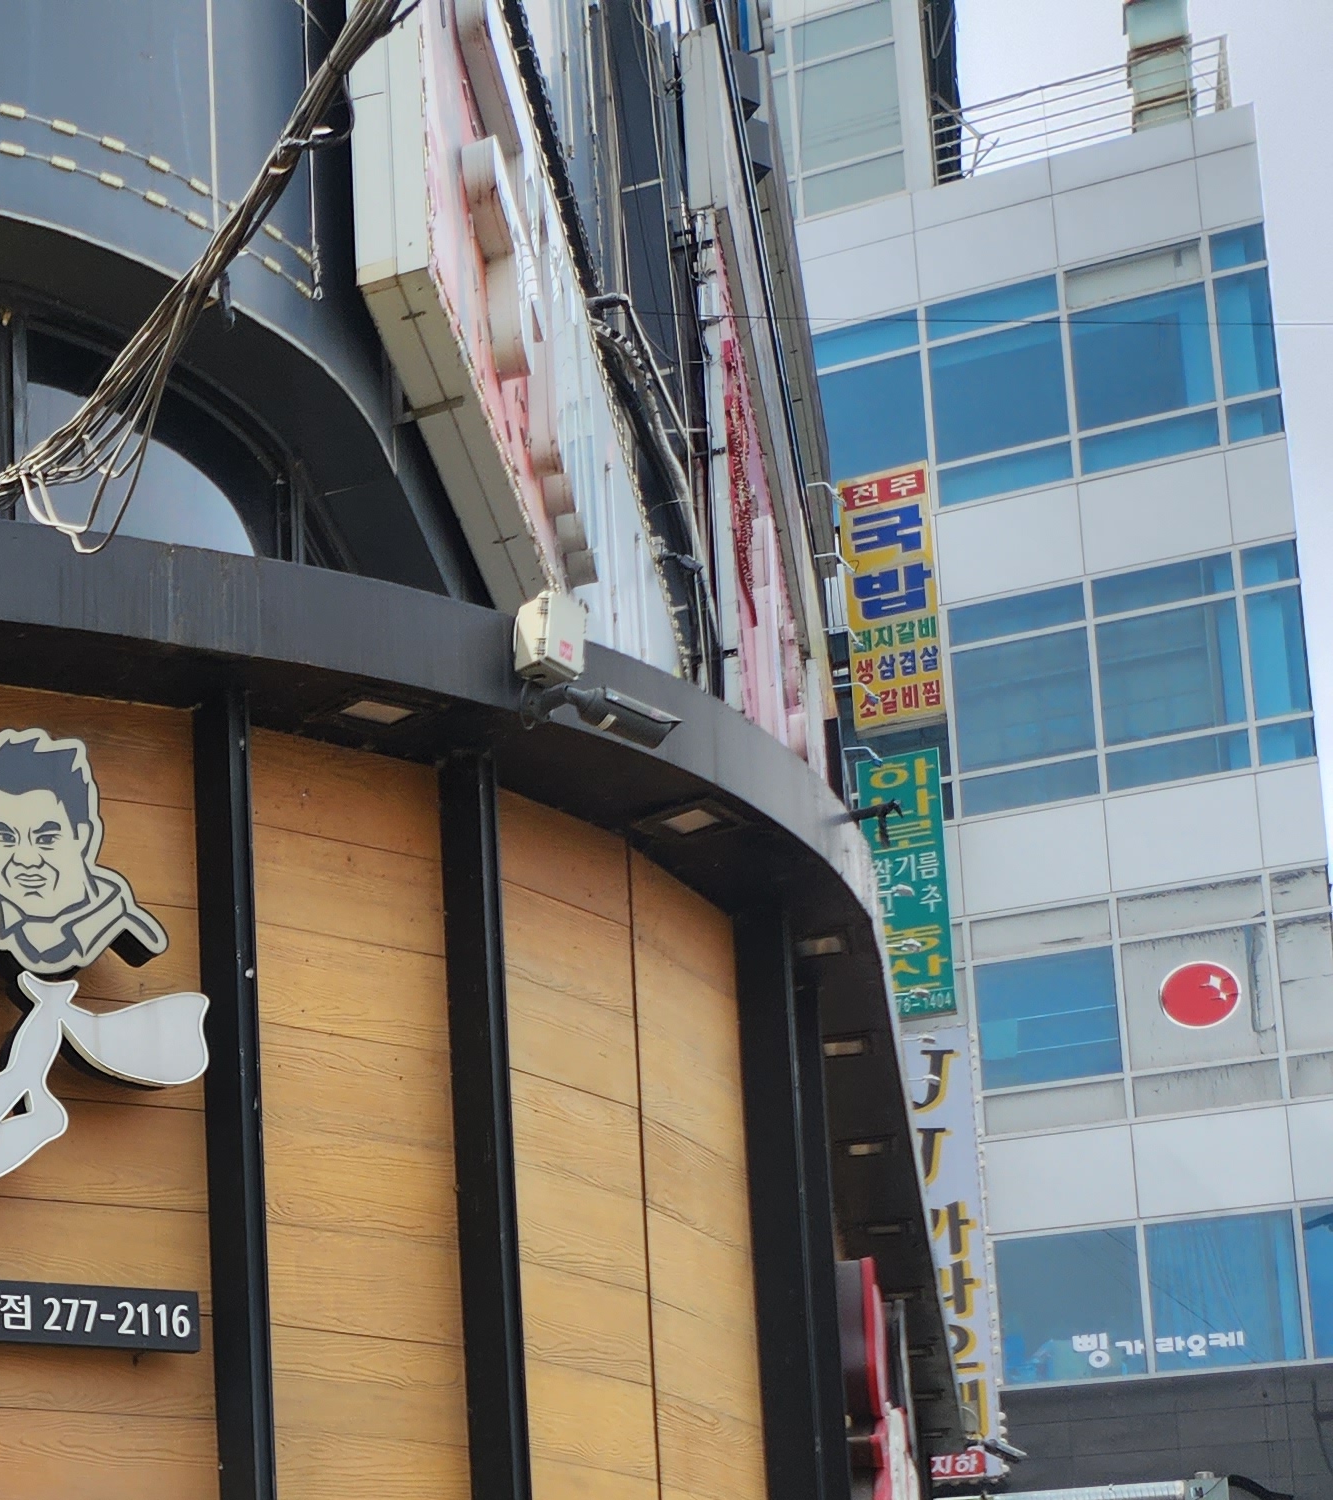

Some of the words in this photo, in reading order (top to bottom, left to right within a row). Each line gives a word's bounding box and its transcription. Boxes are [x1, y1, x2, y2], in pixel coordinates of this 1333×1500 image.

[852, 474, 918, 508] 전주
[851, 503, 933, 621] 국밥
[851, 615, 938, 654] 돼지갈비
[855, 645, 939, 686] 생삼겹살
[859, 679, 941, 719] 소갈비찜
[873, 851, 940, 887] 참기름
[42, 1295, 193, 1340] 277-2116
[1114, 1330, 1245, 1358] 가라오케
[931, 1451, 978, 1476] 지하
